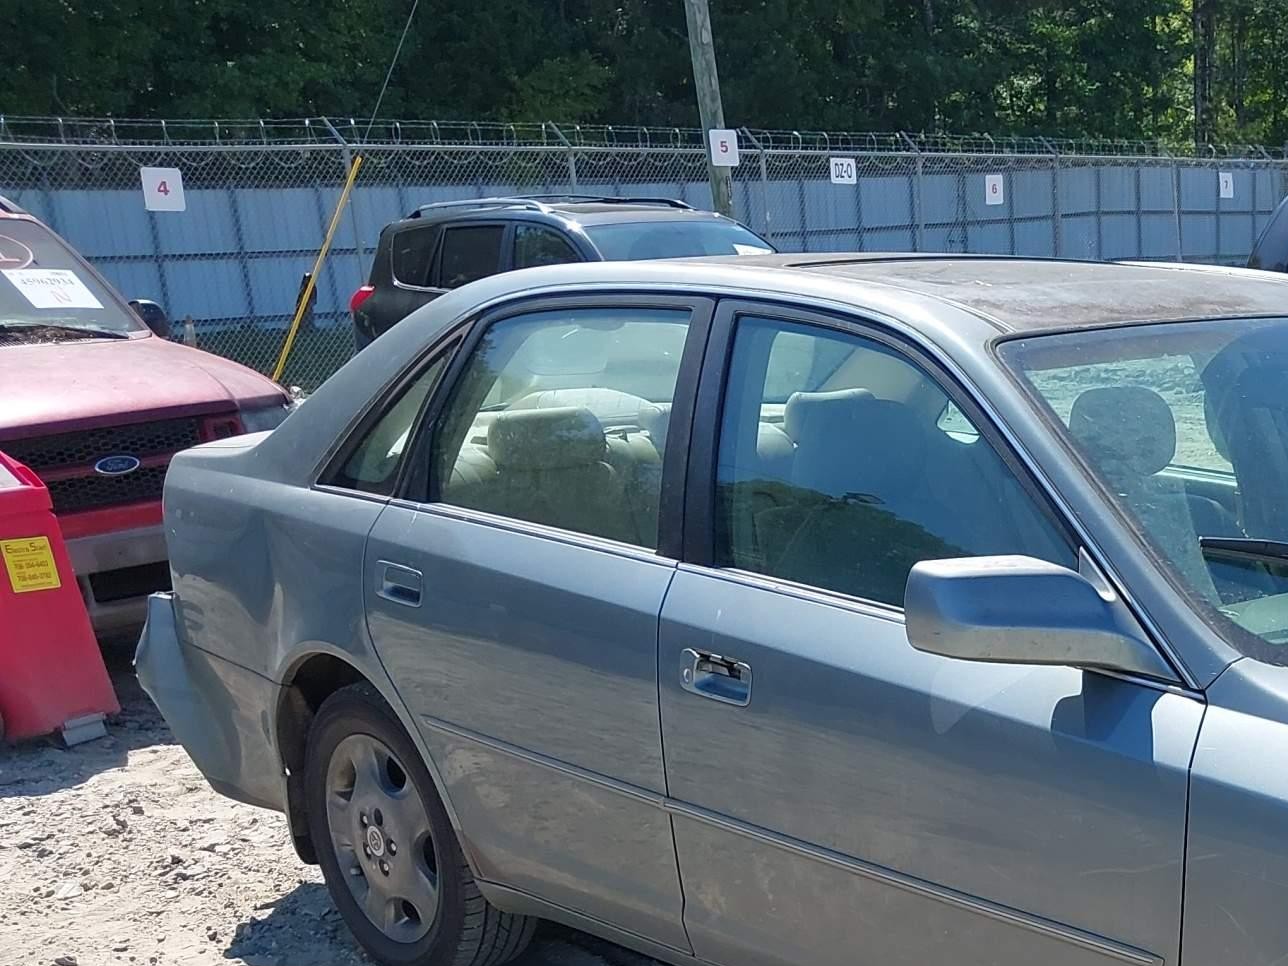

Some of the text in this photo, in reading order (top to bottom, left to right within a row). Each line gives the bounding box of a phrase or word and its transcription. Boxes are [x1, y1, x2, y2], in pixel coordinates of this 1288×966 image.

[719, 140, 729, 153] 5
[157, 180, 170, 196] 4
[991, 183, 998, 194] 6
[1224, 179, 1229, 190] 7
